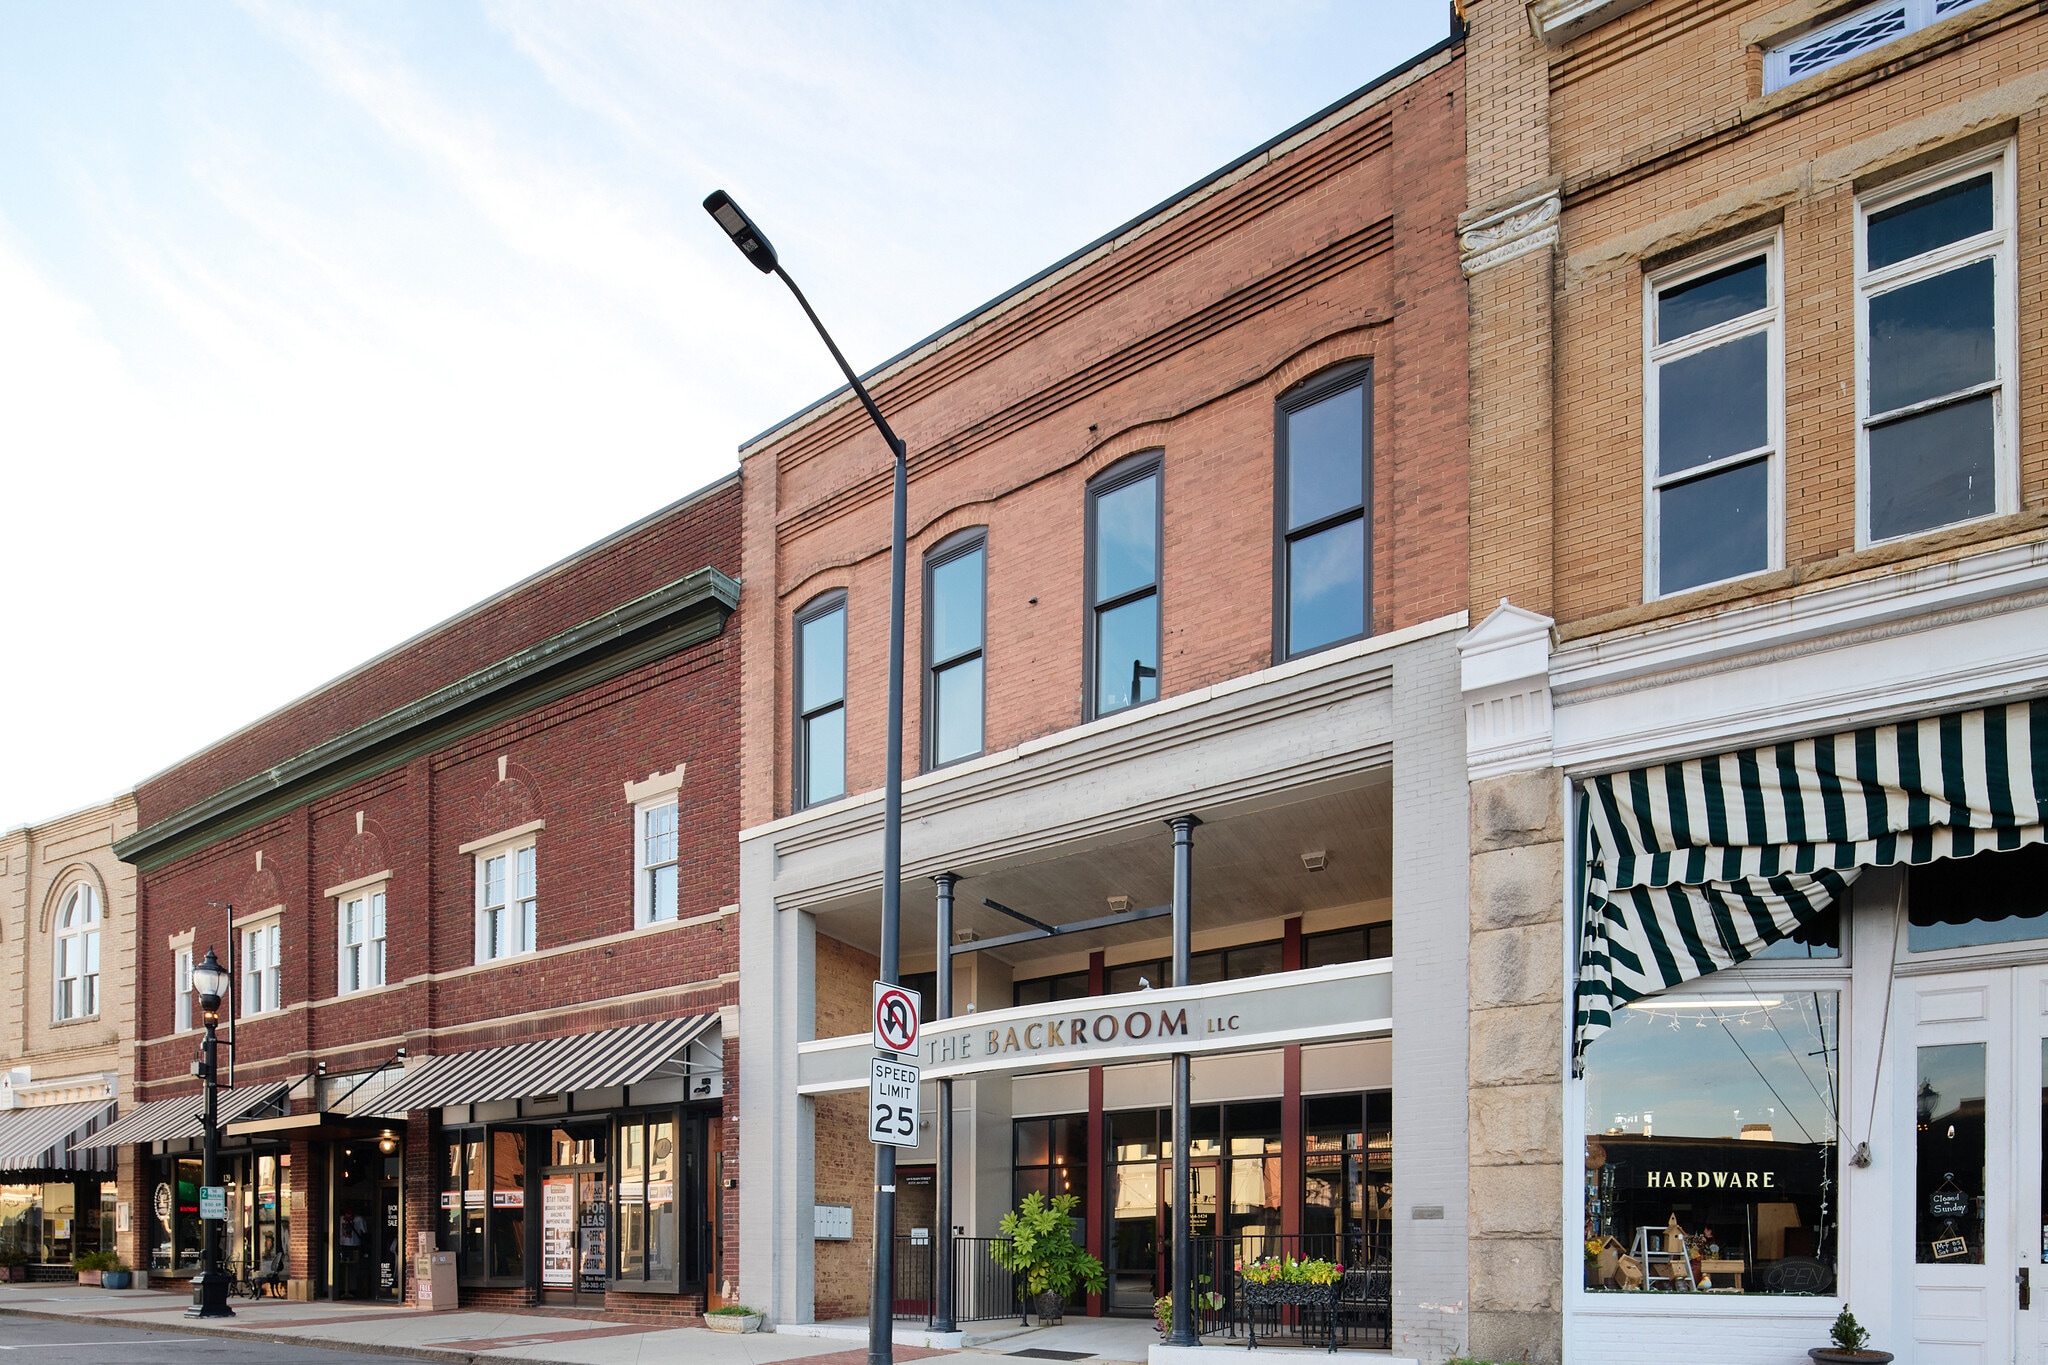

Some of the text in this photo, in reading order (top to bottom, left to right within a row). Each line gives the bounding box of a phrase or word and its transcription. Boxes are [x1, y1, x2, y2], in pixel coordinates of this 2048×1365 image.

[926, 1008, 1239, 1065] THE BACKROOM LLC
[876, 1065, 916, 1083] SPEED
[879, 1082, 911, 1099] LIMIT
[875, 1103, 914, 1136] 25
[1647, 1171, 1775, 1188] HARDWARE
[202, 1189, 207, 1198] 2
[1933, 1193, 1960, 1203] Closed
[586, 1203, 605, 1214] FOR
[1934, 1203, 1966, 1214] Sunday
[581, 1215, 605, 1226] LEAS
[1767, 1267, 1826, 1286] OPEN
